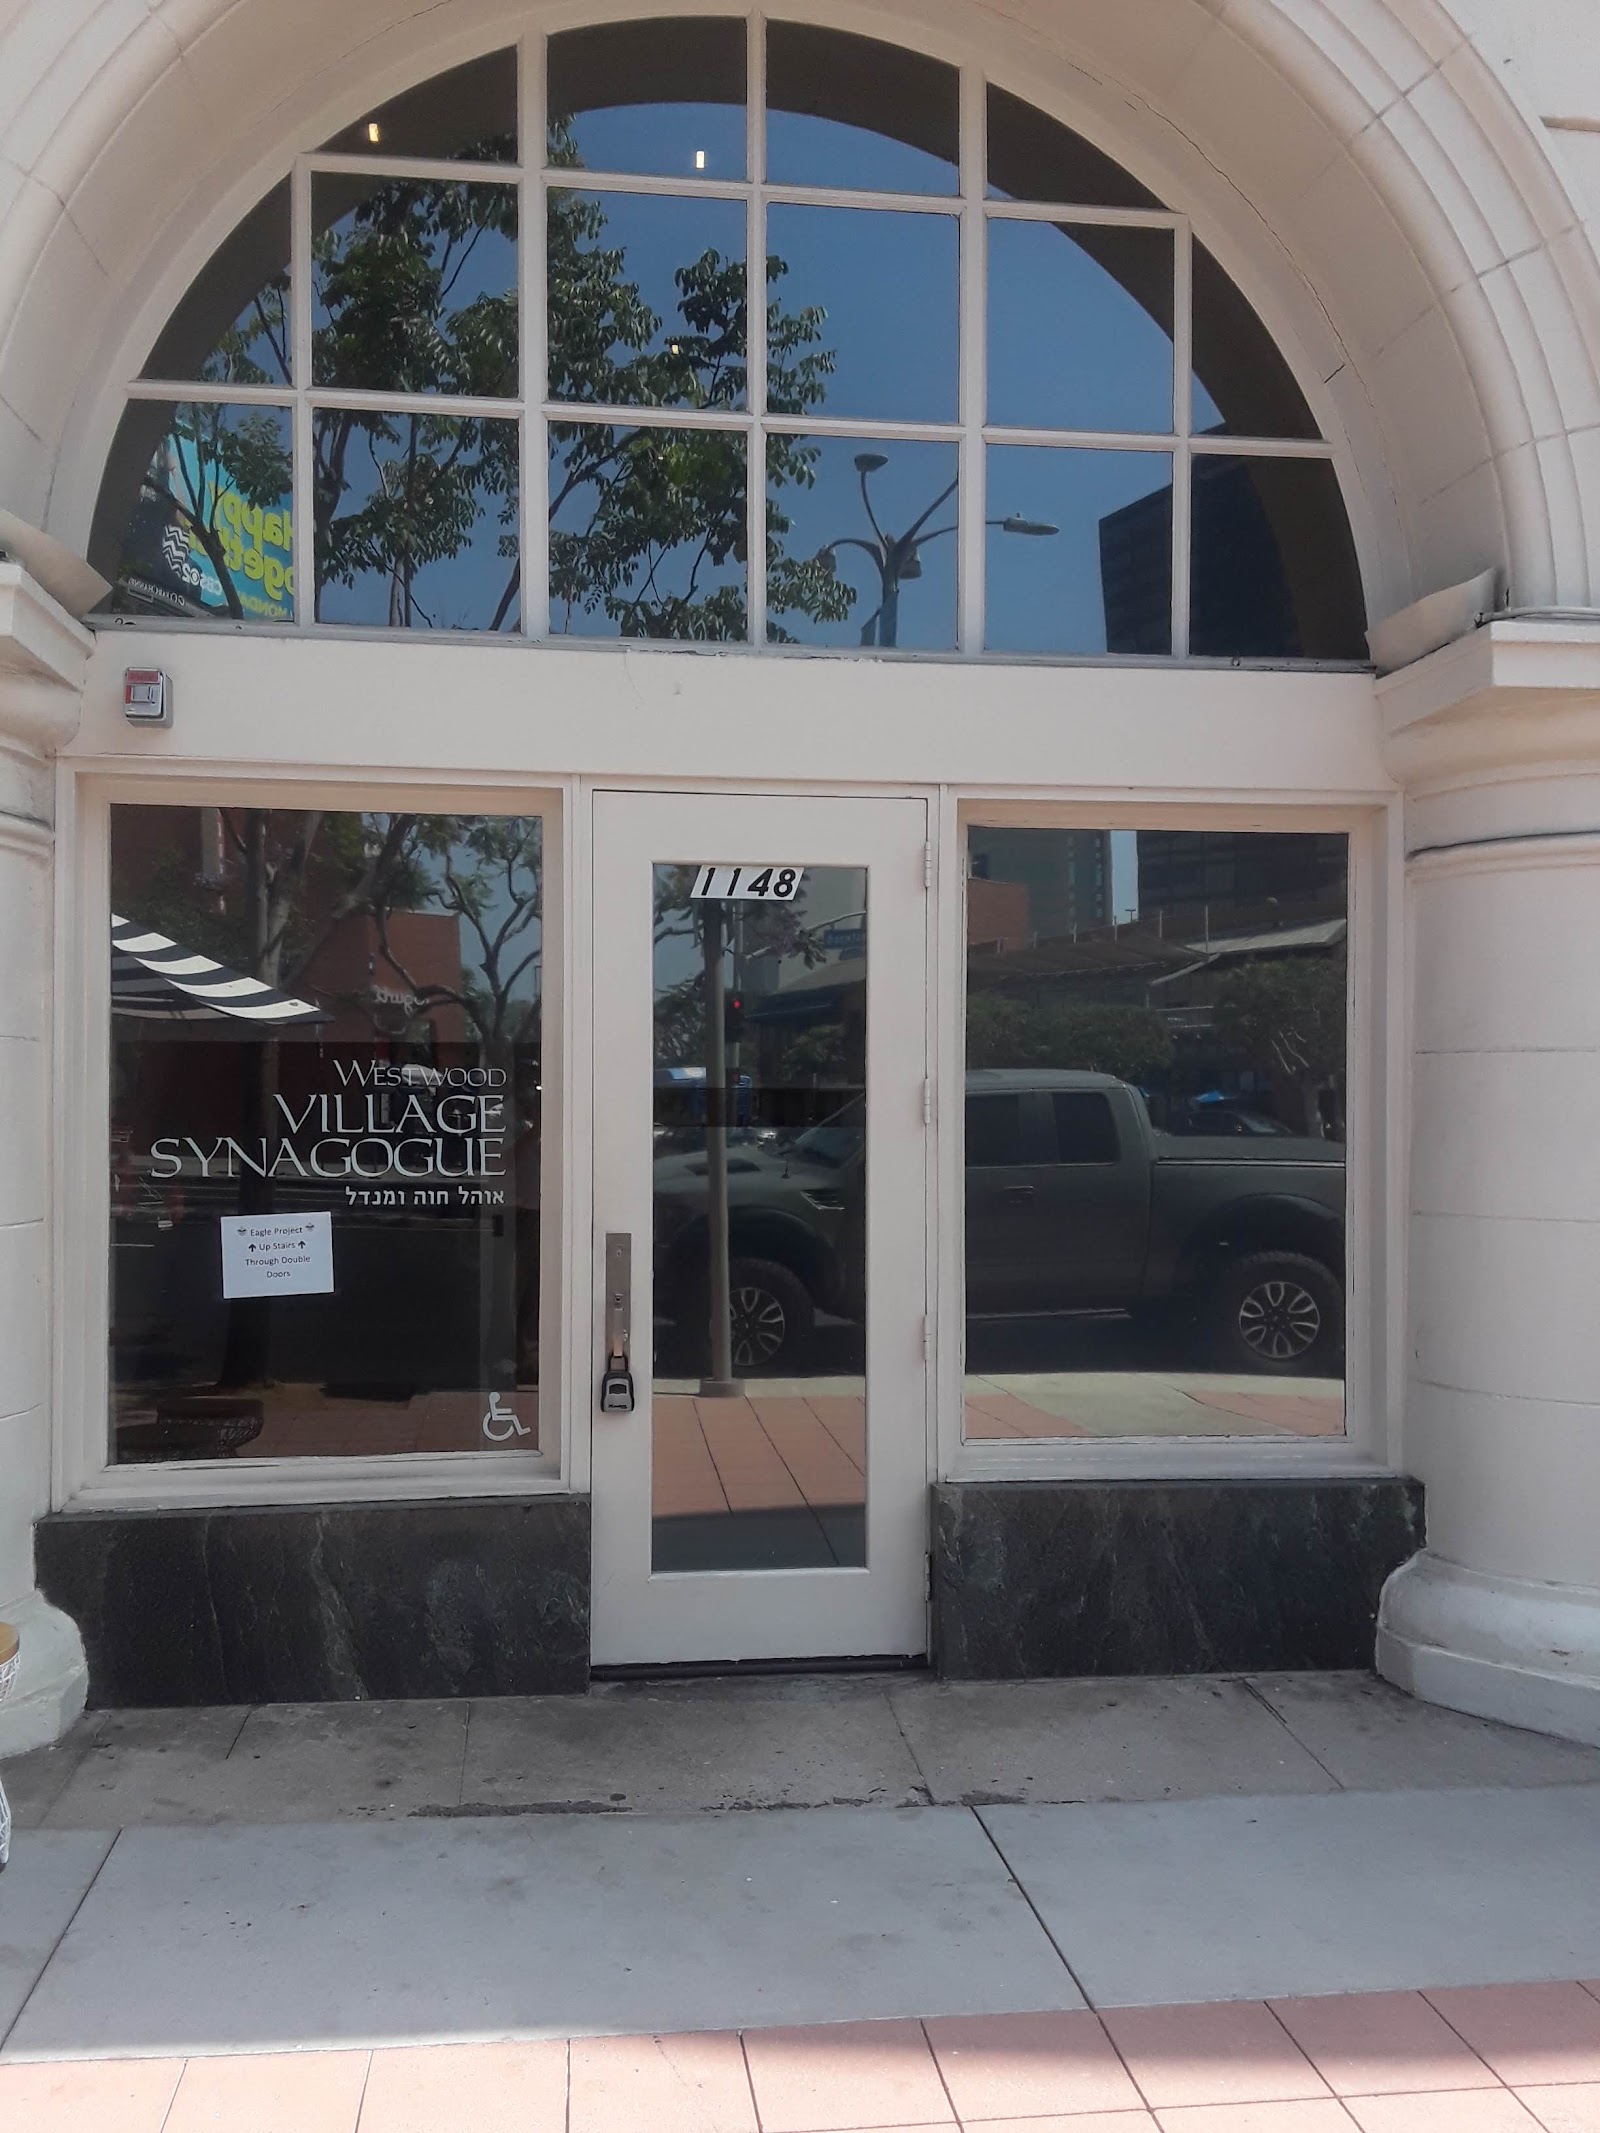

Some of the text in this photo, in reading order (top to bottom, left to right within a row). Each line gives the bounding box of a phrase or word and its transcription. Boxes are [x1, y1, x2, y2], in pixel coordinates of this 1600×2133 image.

[701, 867, 796, 897] 1148
[273, 1094, 506, 1134] VILLAGE
[149, 1137, 506, 1178] SYNAGOGUE
[345, 1185, 505, 1205] אוהל חוה ומנדל
[250, 1226, 303, 1237] Eagle Project
[258, 1241, 296, 1252] Up Stairs
[245, 1255, 311, 1266] Through Double
[266, 1270, 291, 1278] Doors
